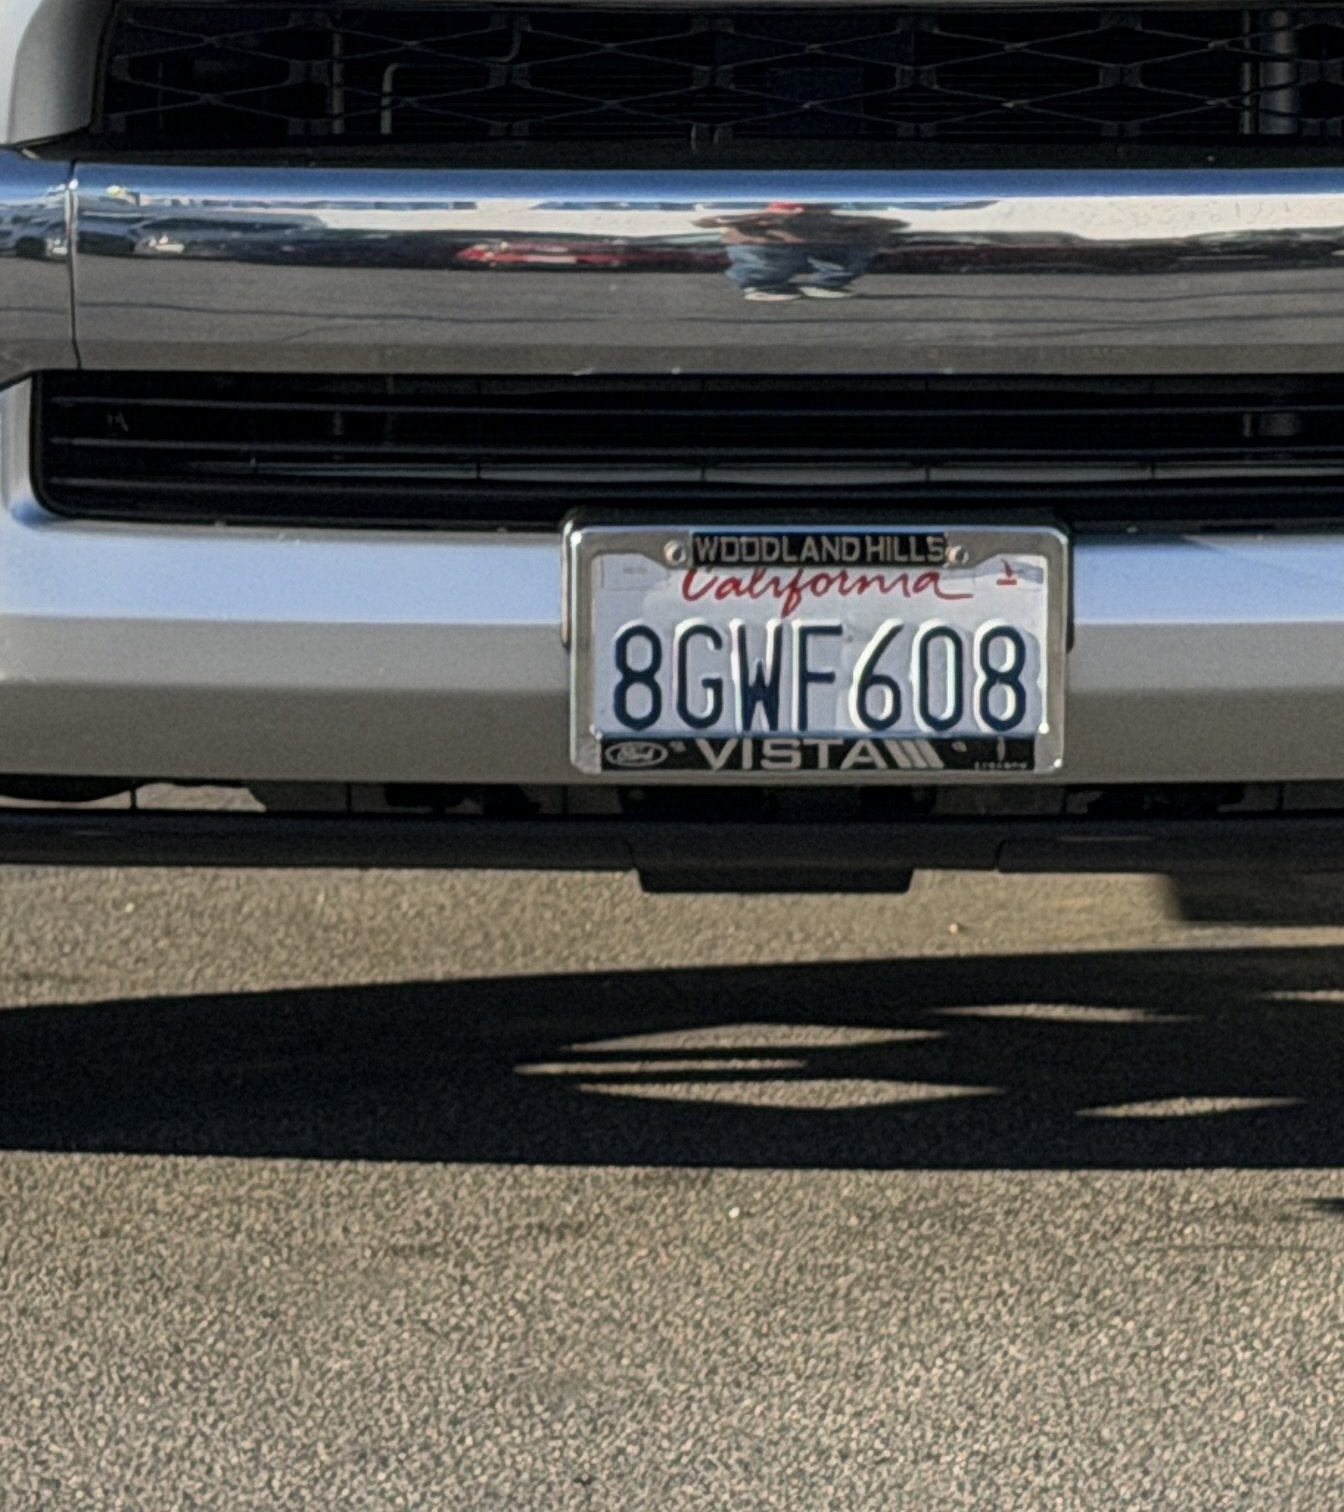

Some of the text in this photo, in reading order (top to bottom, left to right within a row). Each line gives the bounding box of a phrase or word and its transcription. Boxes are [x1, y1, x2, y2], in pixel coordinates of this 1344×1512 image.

[695, 536, 947, 563] WOODLAND HILLS
[681, 569, 974, 618] California
[613, 623, 1026, 731] 8GWF608
[694, 738, 885, 771] VISTA
